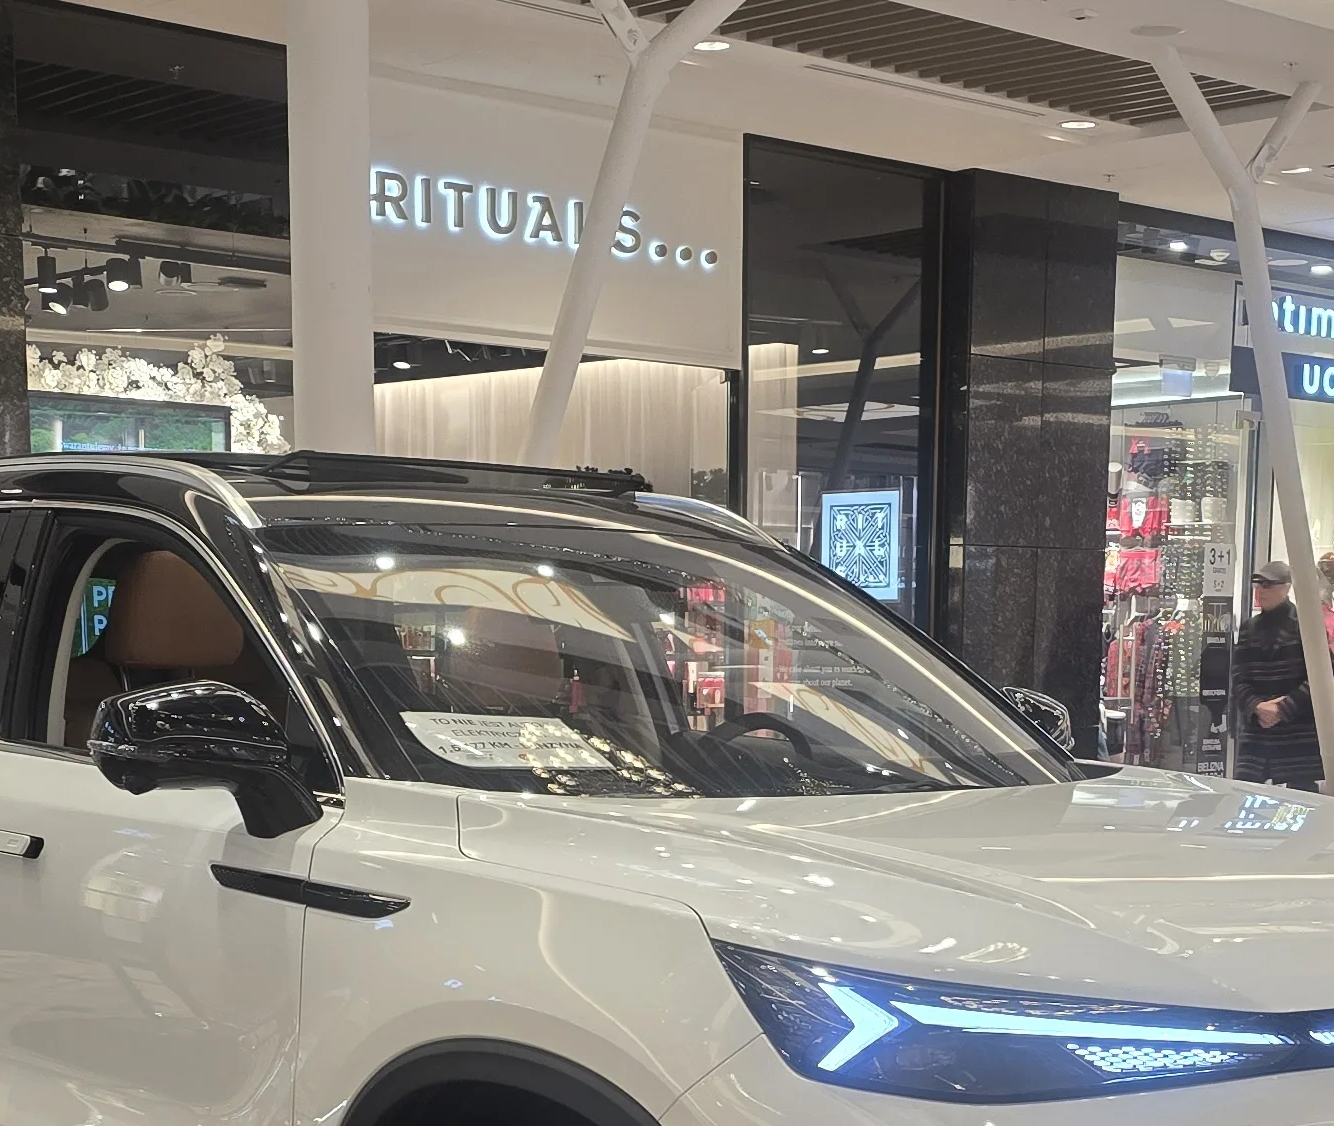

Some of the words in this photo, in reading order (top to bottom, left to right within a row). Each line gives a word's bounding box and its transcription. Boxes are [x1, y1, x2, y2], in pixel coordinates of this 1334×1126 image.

[453, 718, 477, 727] NIE
[479, 719, 505, 728] JEST
[490, 741, 513, 749] KM
